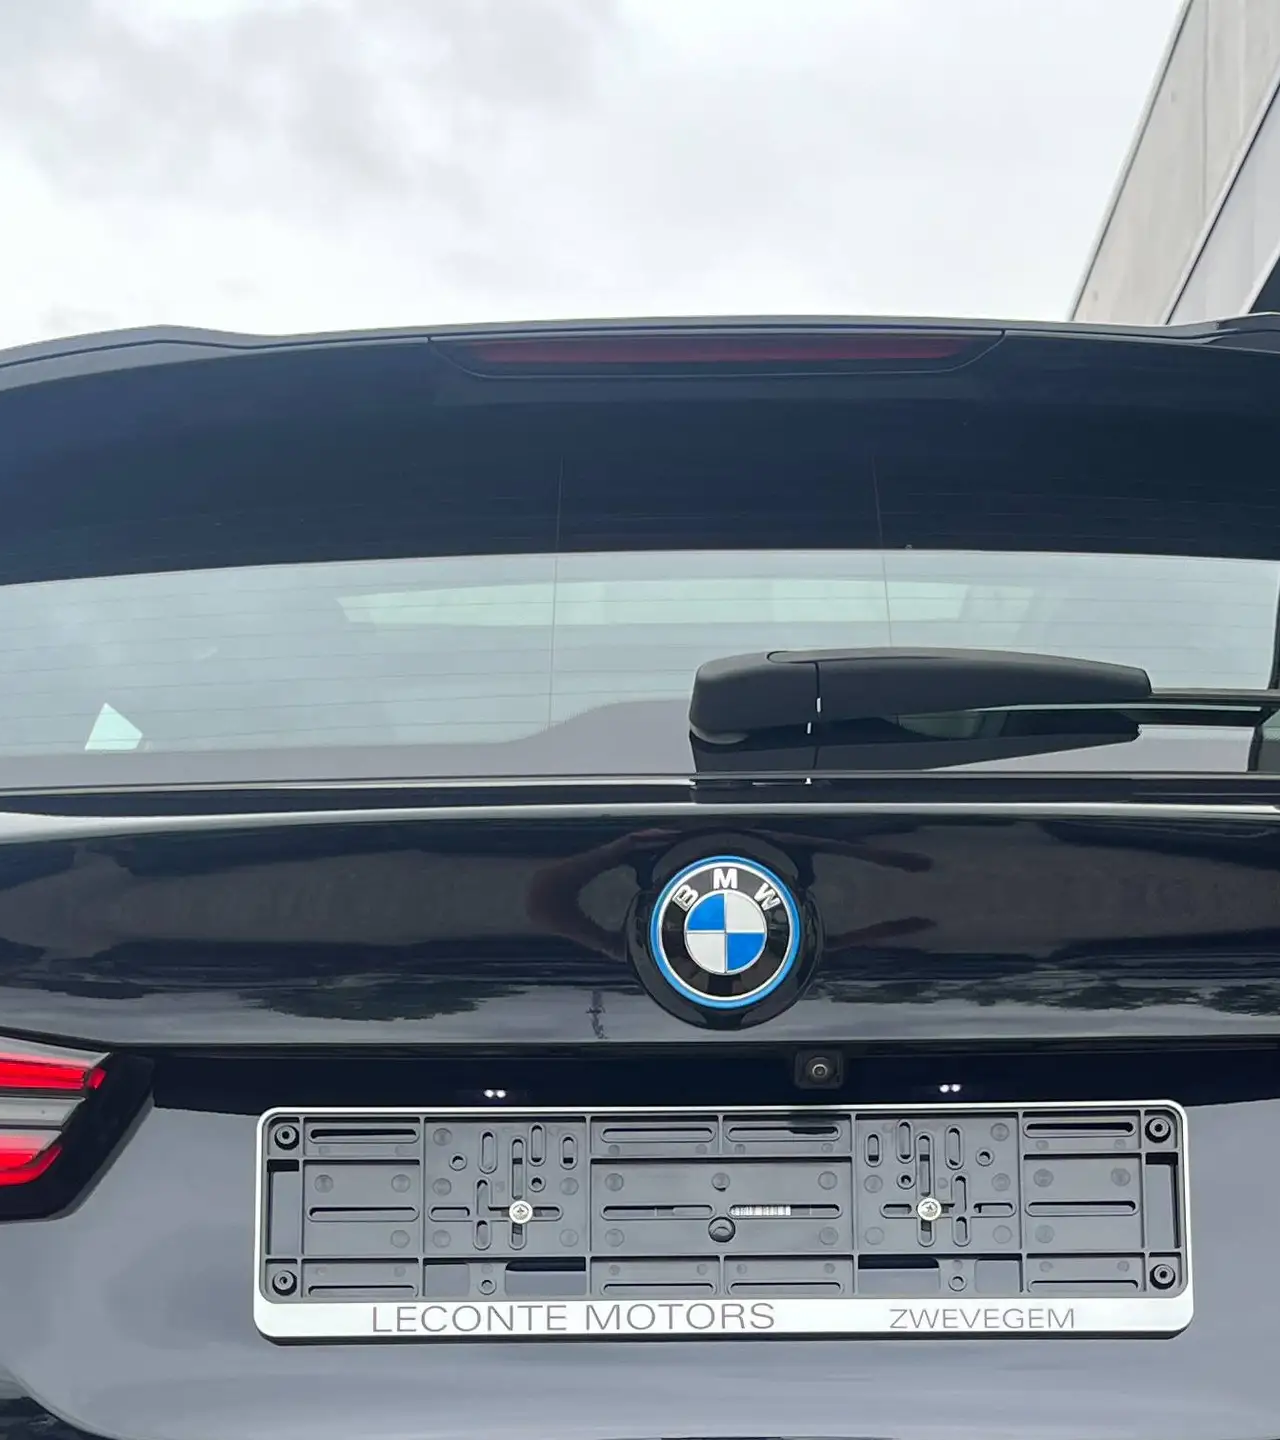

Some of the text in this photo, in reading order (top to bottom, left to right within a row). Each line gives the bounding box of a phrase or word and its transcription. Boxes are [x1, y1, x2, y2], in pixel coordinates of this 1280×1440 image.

[672, 868, 780, 912] BMW
[372, 1303, 1075, 1333] LECONTE MOTORS ZWEVEGEM
